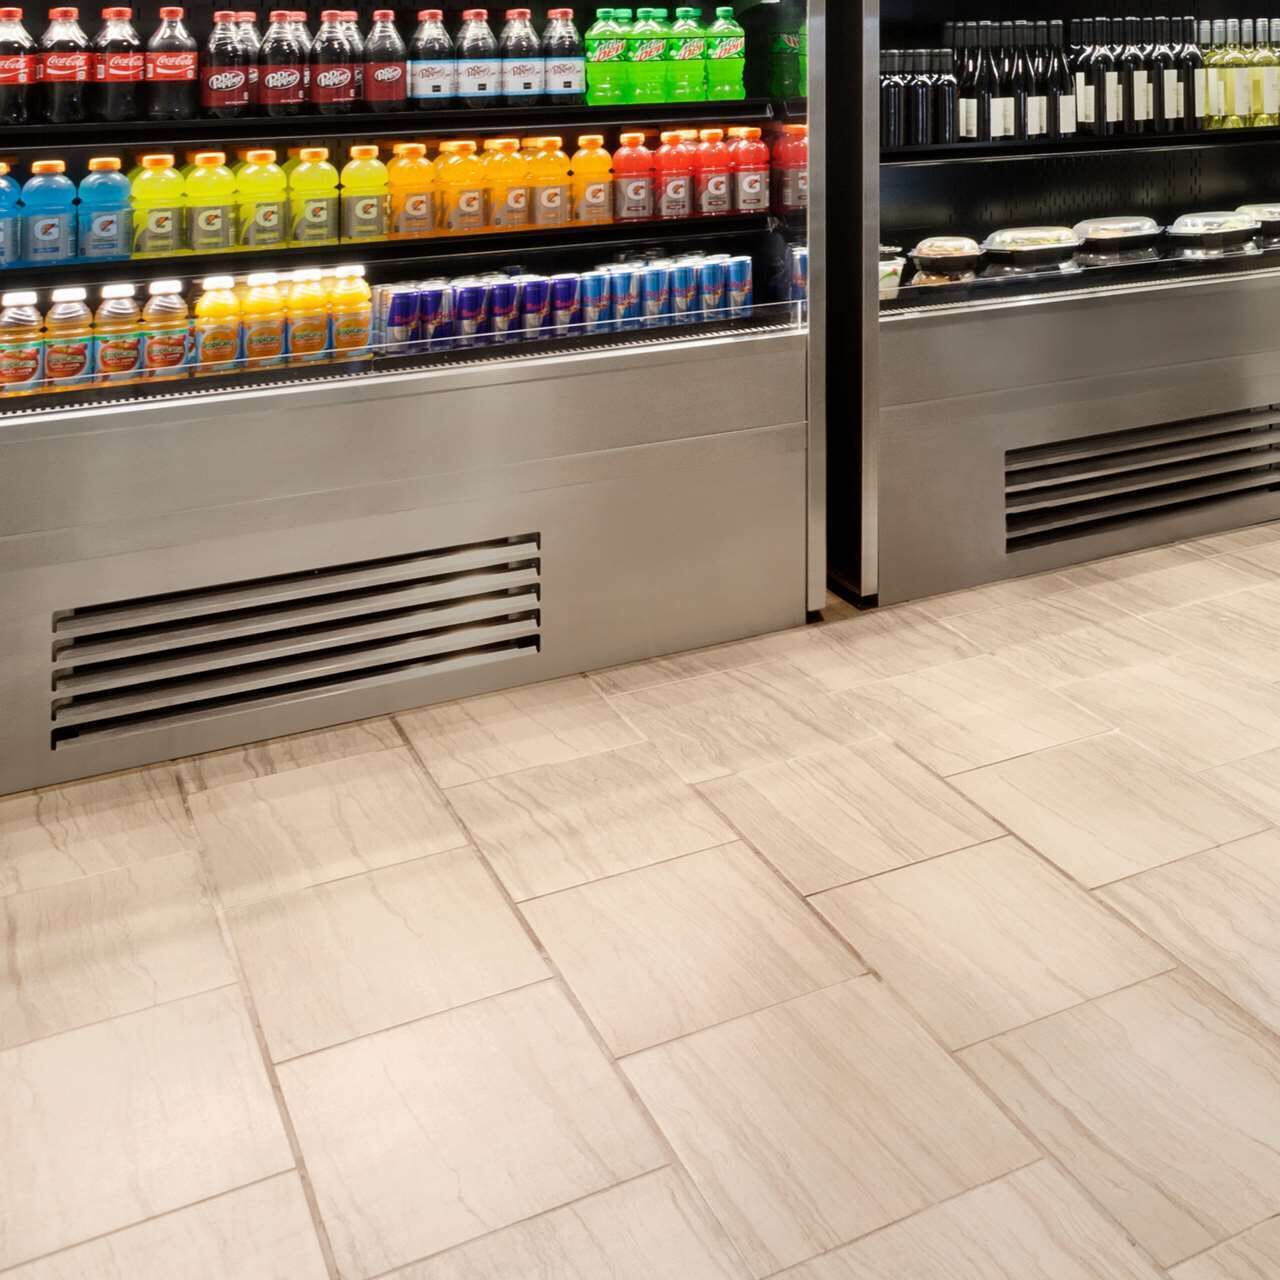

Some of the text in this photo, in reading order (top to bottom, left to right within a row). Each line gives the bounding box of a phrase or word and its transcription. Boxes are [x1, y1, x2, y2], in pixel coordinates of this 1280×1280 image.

[47, 55, 86, 69] Coca-Cola
[156, 55, 194, 69] Coca-Cola
[255, 205, 278, 227] G
[305, 202, 327, 223] G
[356, 198, 378, 219] G
[34, 218, 59, 239] G
[93, 215, 117, 236] G
[148, 209, 172, 233] G
[198, 209, 222, 233] G
